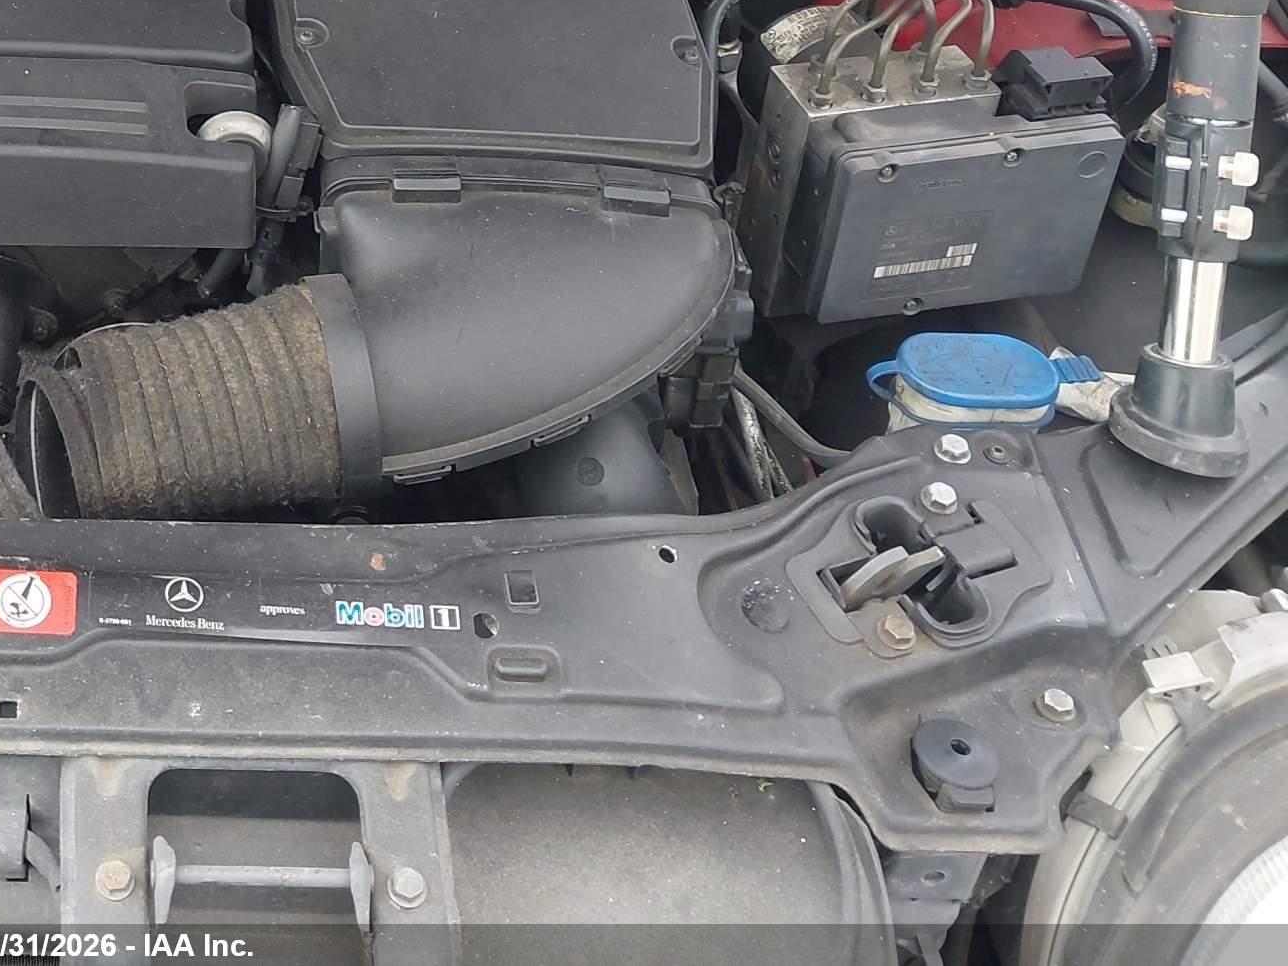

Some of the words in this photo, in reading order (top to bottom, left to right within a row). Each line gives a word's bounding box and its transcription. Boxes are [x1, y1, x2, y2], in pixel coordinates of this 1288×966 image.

[259, 604, 306, 616] approves
[335, 600, 425, 629] Mobil
[145, 614, 196, 630] Mercedes
[197, 617, 225, 632] Benz
